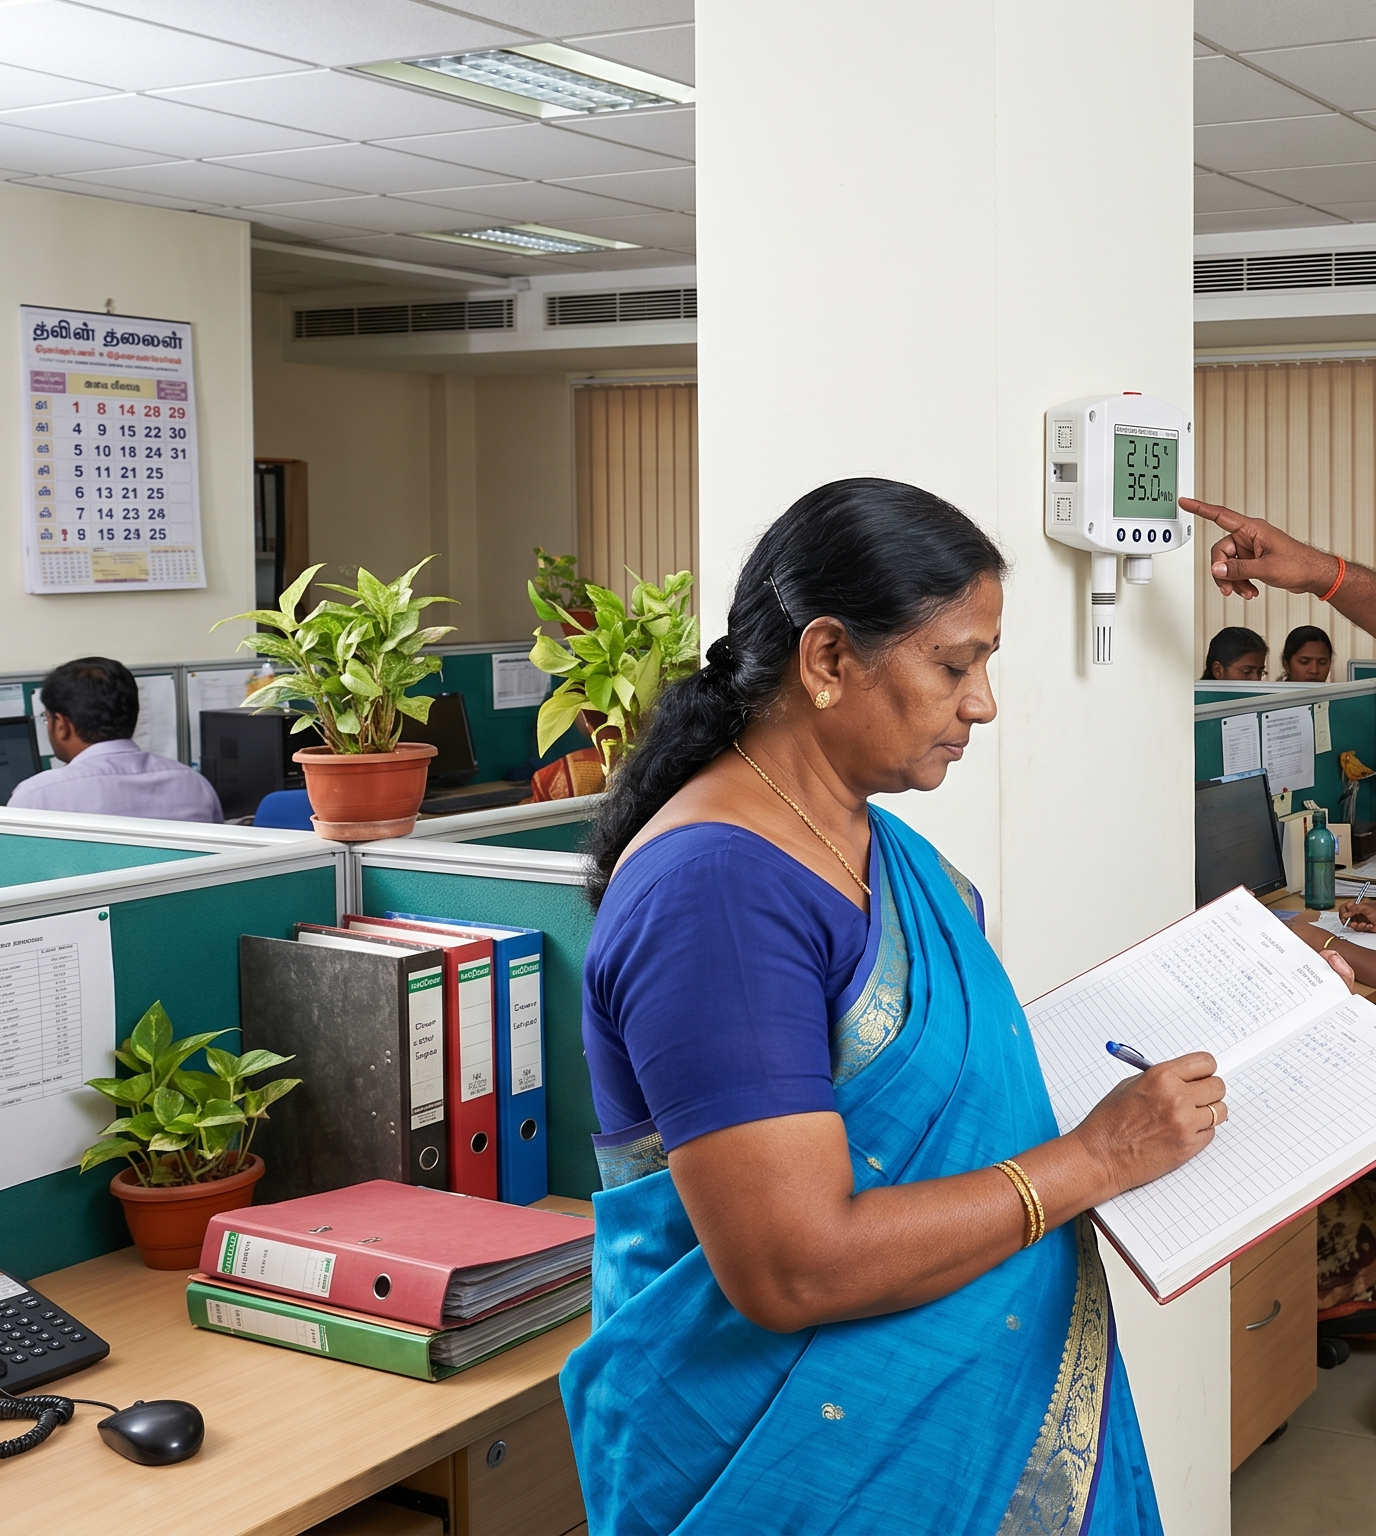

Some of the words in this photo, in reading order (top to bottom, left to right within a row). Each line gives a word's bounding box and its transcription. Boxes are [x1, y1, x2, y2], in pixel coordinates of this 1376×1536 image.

[72, 401, 79, 414] 1
[97, 402, 106, 415] 8
[119, 404, 136, 416] 14
[144, 405, 161, 418] 28
[168, 407, 186, 419] 29
[72, 423, 82, 435] 4
[97, 423, 107, 436] 9
[119, 425, 136, 437] 15
[144, 426, 162, 438] 22
[169, 427, 186, 439] 30
[74, 444, 83, 456] 5
[94, 444, 111, 457] 10
[120, 446, 137, 458] 18
[145, 446, 162, 459] 24
[170, 447, 186, 460] 31
[1127, 440, 1160, 470] 21.5
[74, 465, 83, 478] 5
[95, 466, 110, 478] 11
[120, 466, 136, 479] 21
[146, 467, 164, 479] 25
[75, 486, 84, 499] 6
[96, 486, 113, 499] 13
[121, 487, 137, 499] 21
[147, 487, 164, 500] 25
[1127, 472, 1160, 502] 35.0
[76, 507, 85, 520] 7
[97, 508, 114, 520] 14
[122, 508, 140, 520] 23
[98, 528, 115, 541] 15
[149, 528, 167, 540] 25
